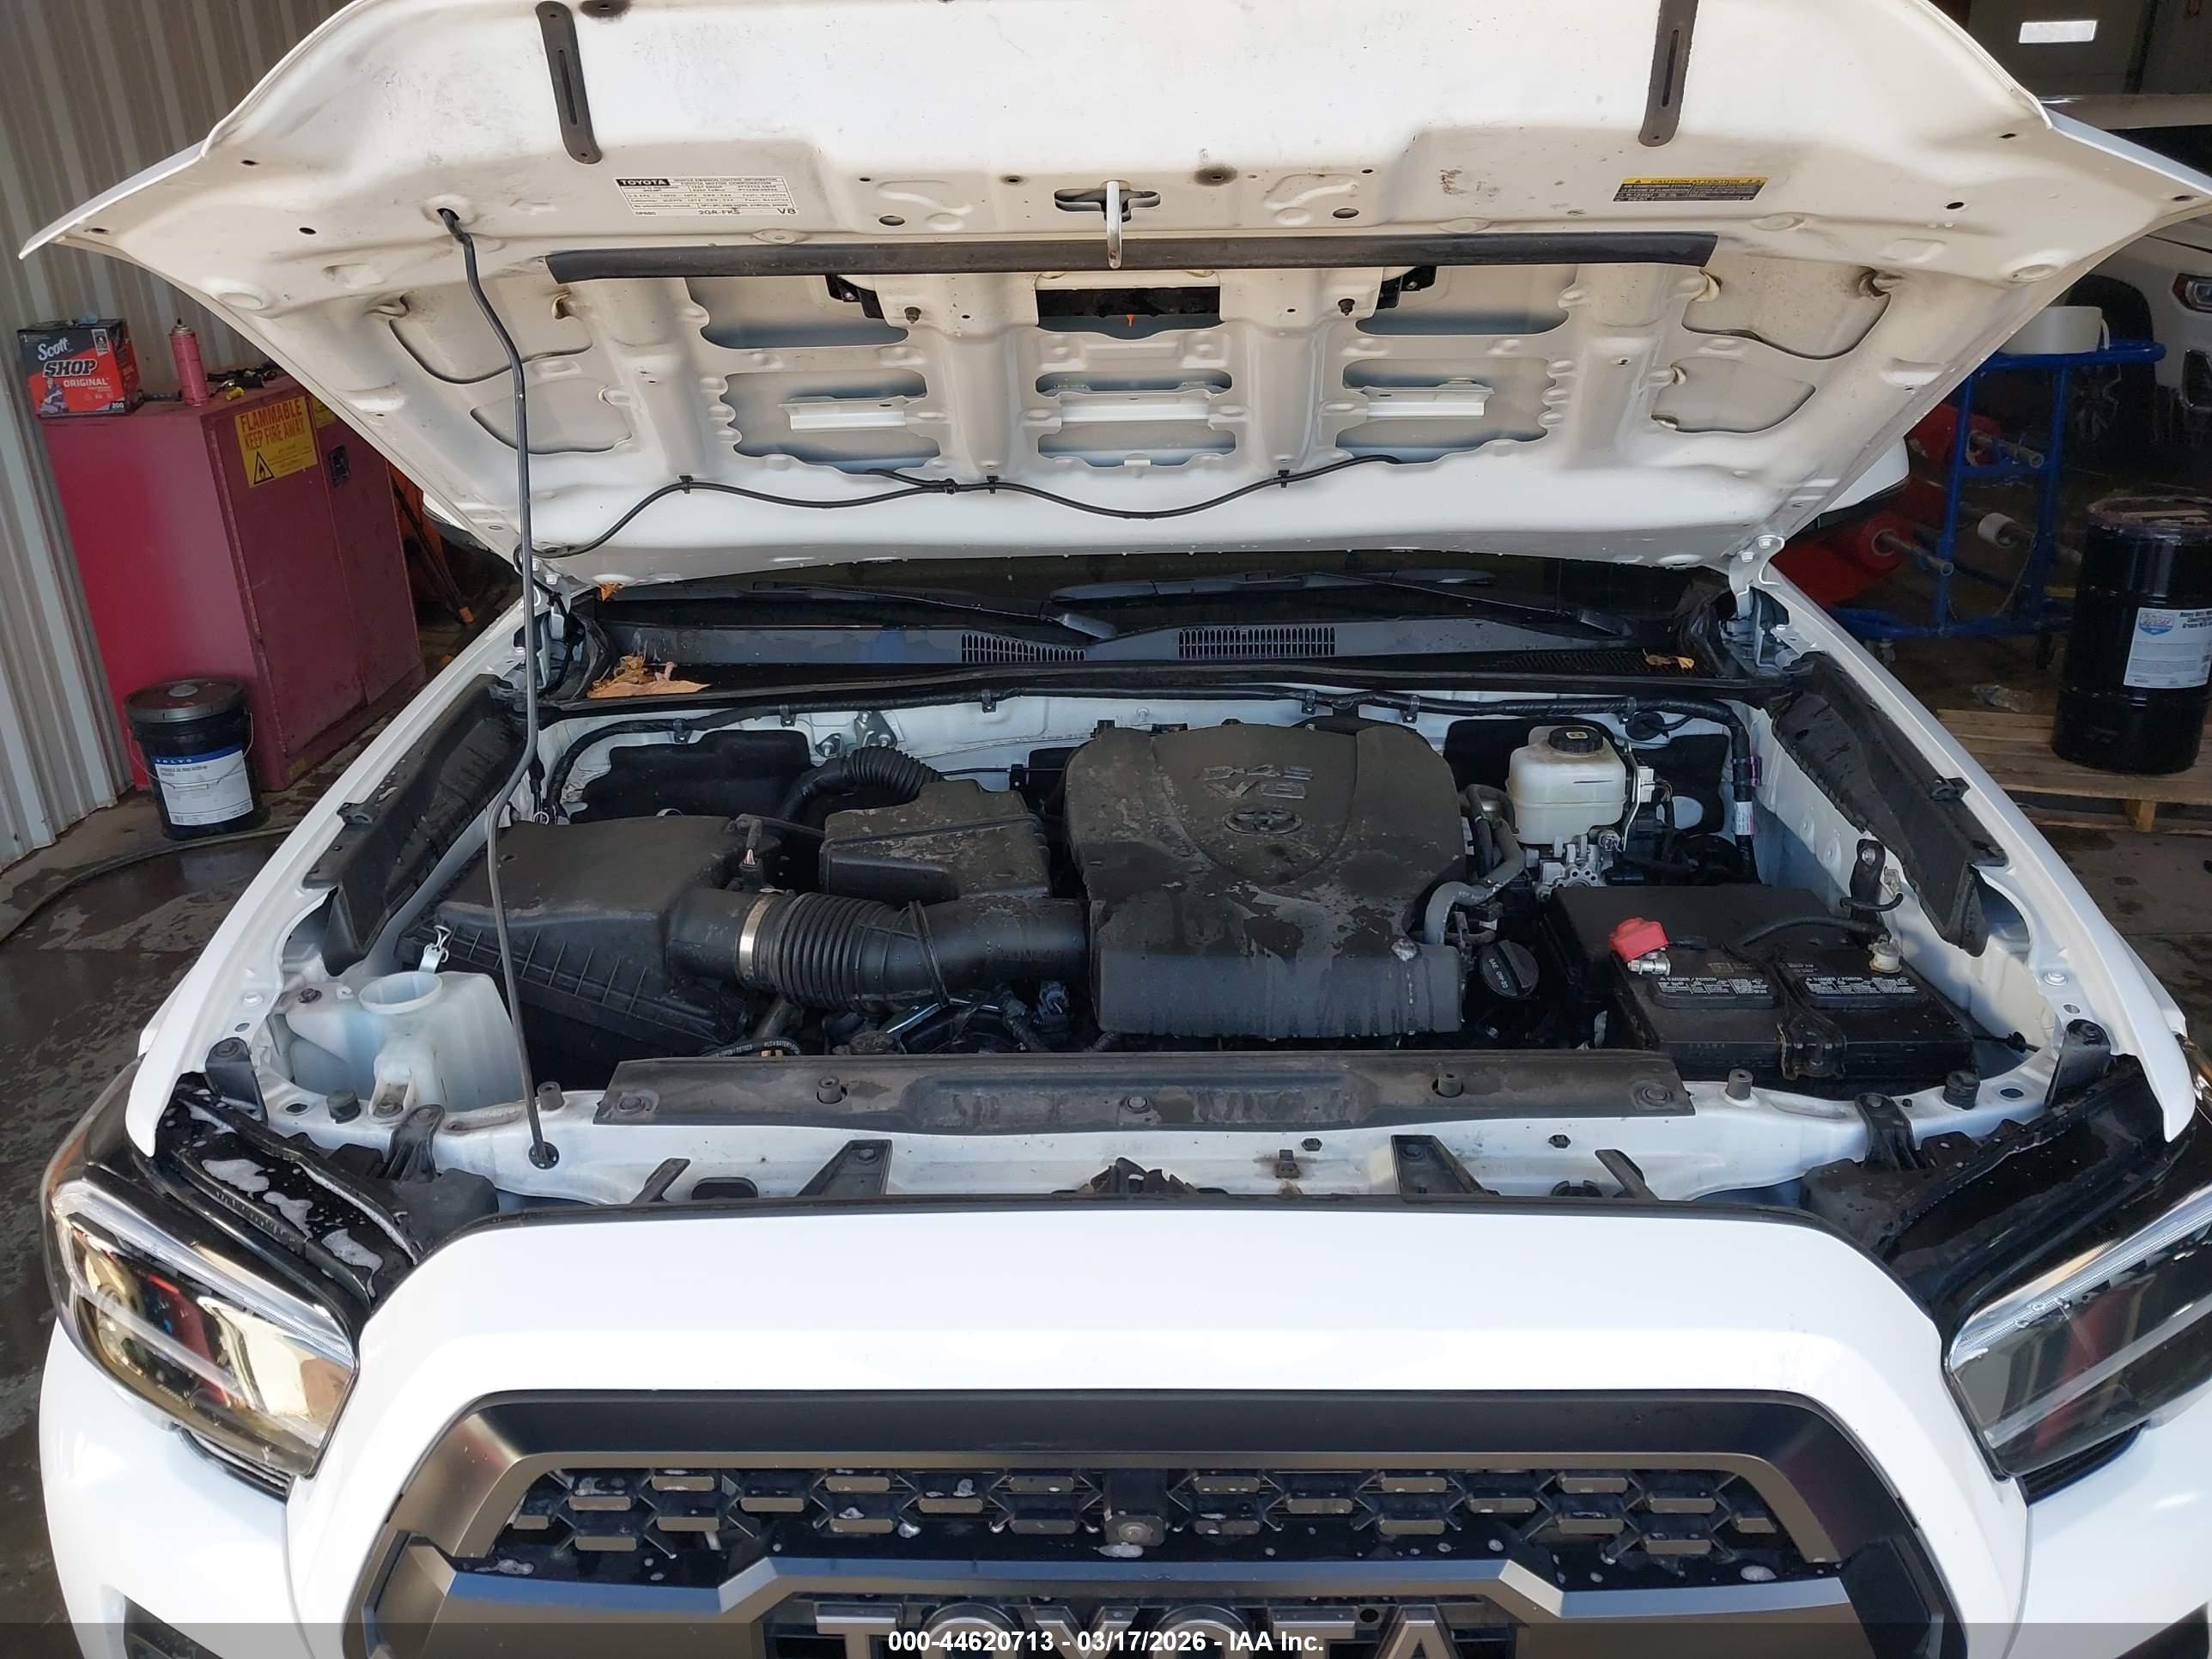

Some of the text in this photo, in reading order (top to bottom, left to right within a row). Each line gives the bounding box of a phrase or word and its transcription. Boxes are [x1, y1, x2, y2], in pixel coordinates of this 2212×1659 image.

[38, 337, 68, 361] Scott
[43, 359, 97, 378] SHOP
[63, 378, 108, 388] ORIGINAL
[240, 398, 303, 431] FLAMMABLE
[243, 417, 305, 452] KEEP FIRE AWAY
[1488, 957, 1499, 969] SAE
